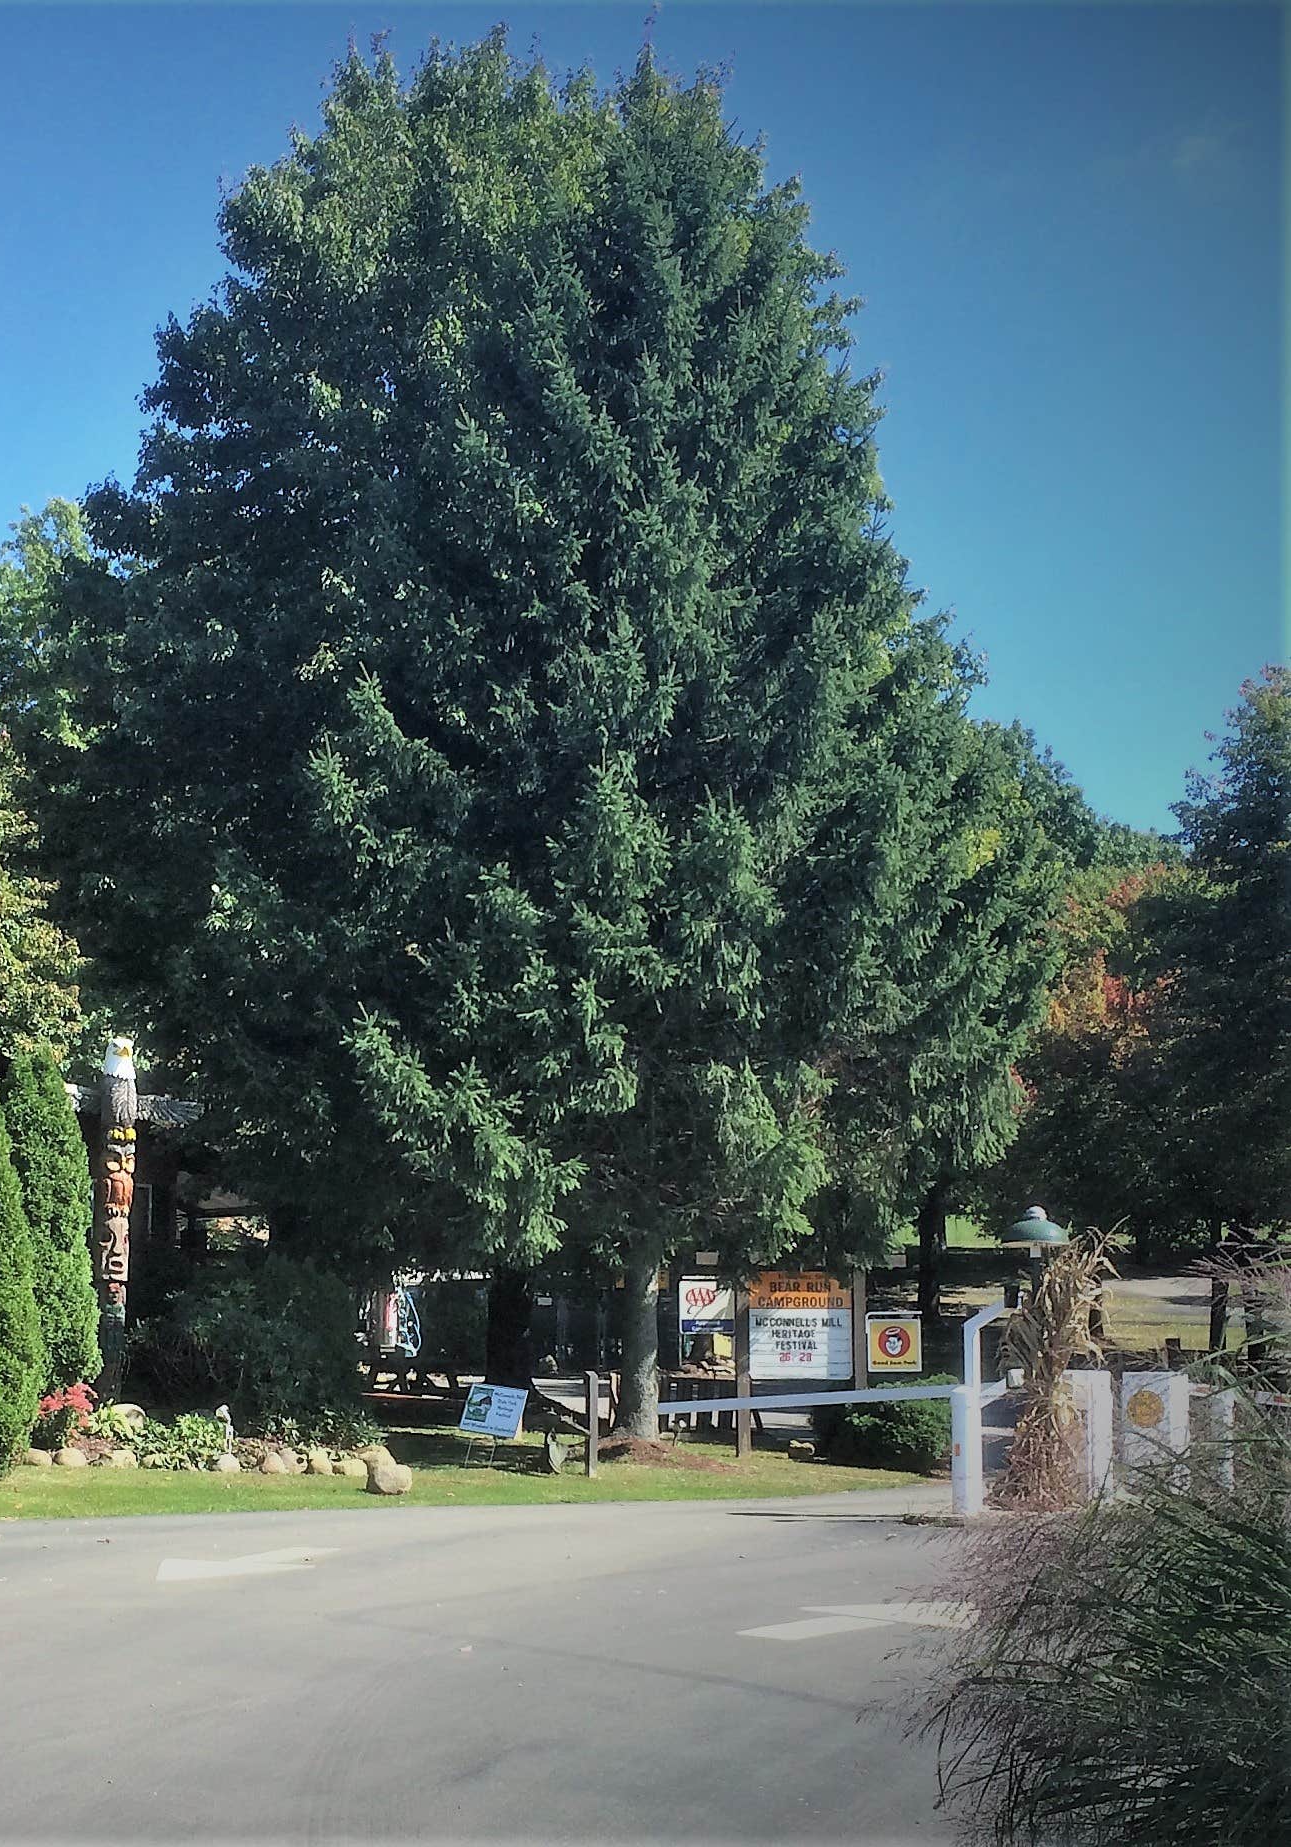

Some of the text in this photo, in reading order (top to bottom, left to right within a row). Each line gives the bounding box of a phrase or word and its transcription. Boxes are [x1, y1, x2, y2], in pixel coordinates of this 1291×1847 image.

[770, 1281, 831, 1293] BEAR RUN
[758, 1296, 844, 1308] CAMPGROUND
[755, 1317, 843, 1328] MCCONNELLS MILL
[775, 1340, 818, 1351] FESTIVAL
